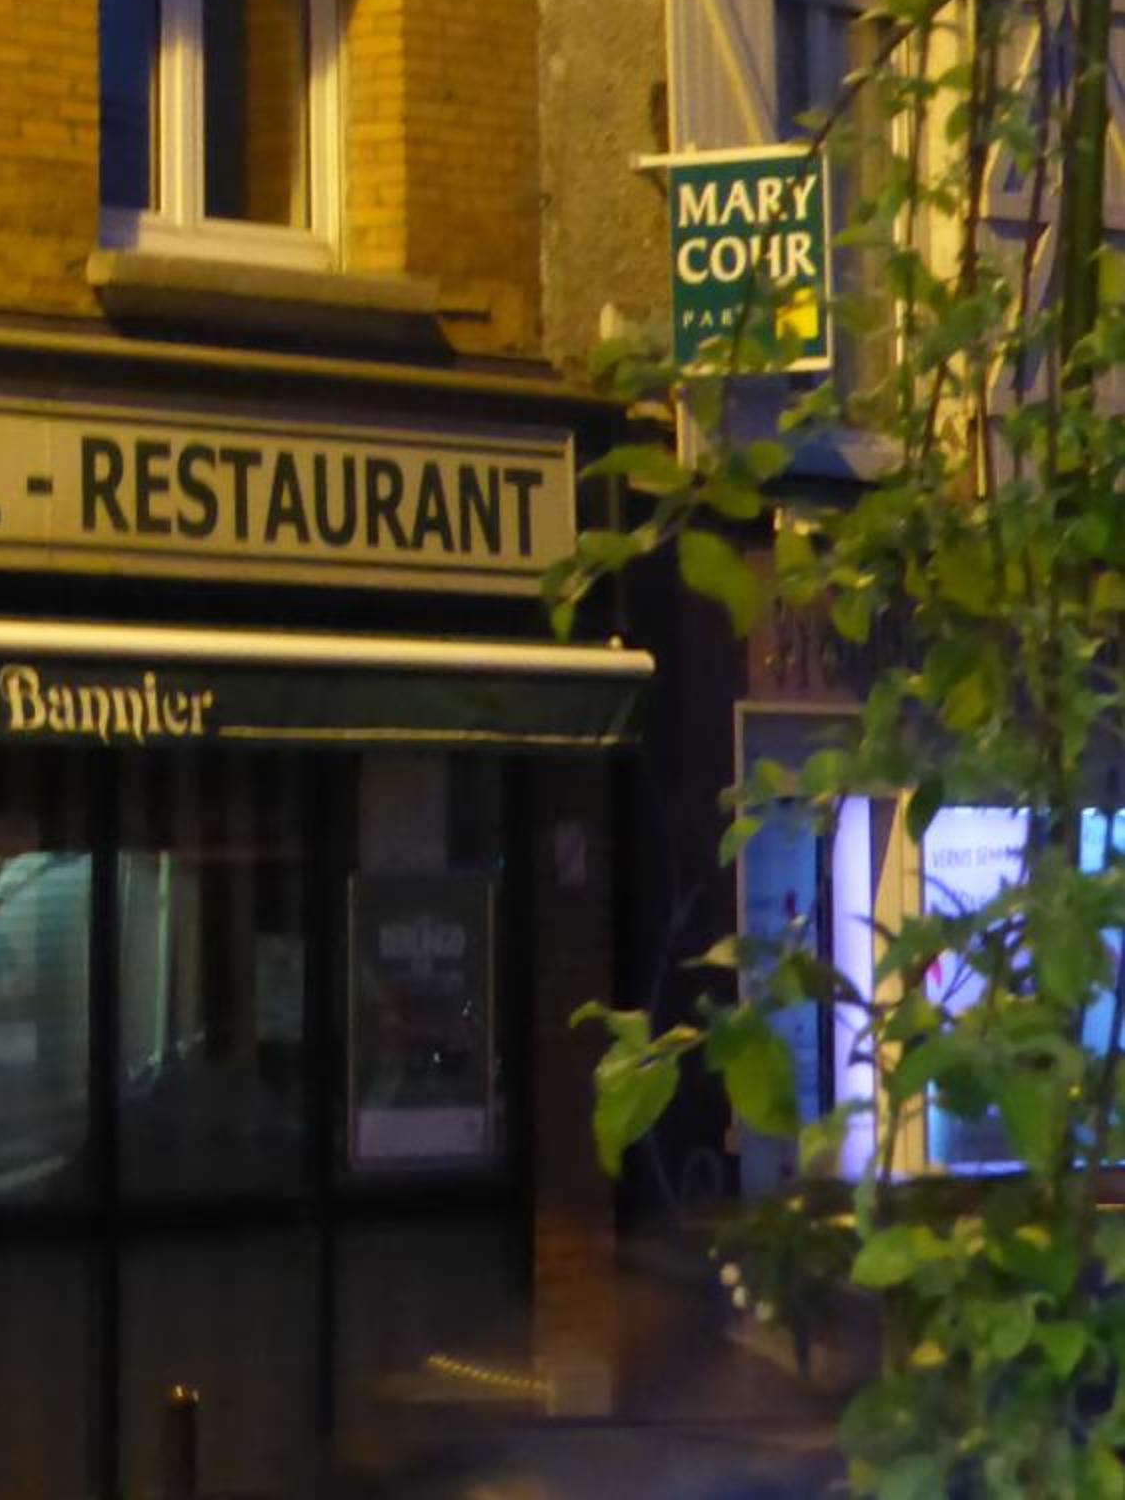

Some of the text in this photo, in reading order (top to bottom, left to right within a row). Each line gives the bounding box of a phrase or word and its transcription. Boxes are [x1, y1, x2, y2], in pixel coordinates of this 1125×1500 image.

[678, 174, 817, 227] MARY
[80, 434, 543, 558] RESTAURANT
[0, 663, 214, 746] Bannier
